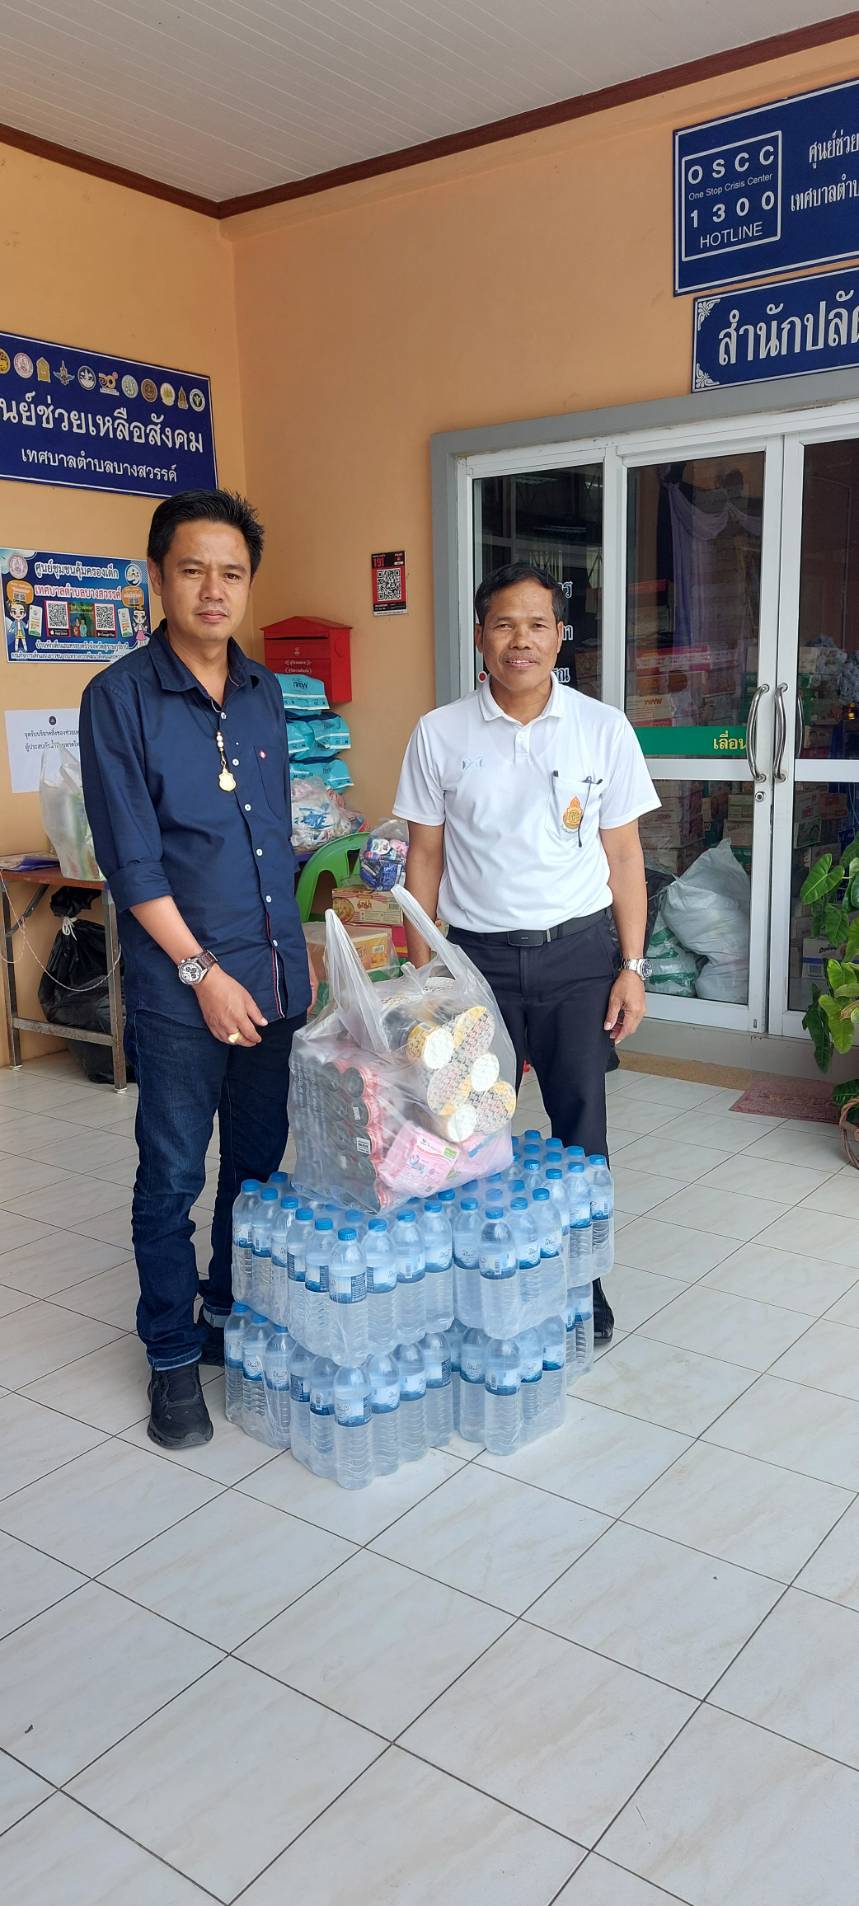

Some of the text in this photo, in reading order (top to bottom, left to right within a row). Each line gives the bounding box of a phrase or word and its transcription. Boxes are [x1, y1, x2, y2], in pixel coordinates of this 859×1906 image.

[688, 173, 773, 201] One Stop Crisis Center
[700, 221, 763, 249] HOTLINE
[21, 448, 177, 482] เทศบาลตำบลบางสวรรค์
[34, 582, 122, 601] เทศบาลตำบลบางสวรรค์
